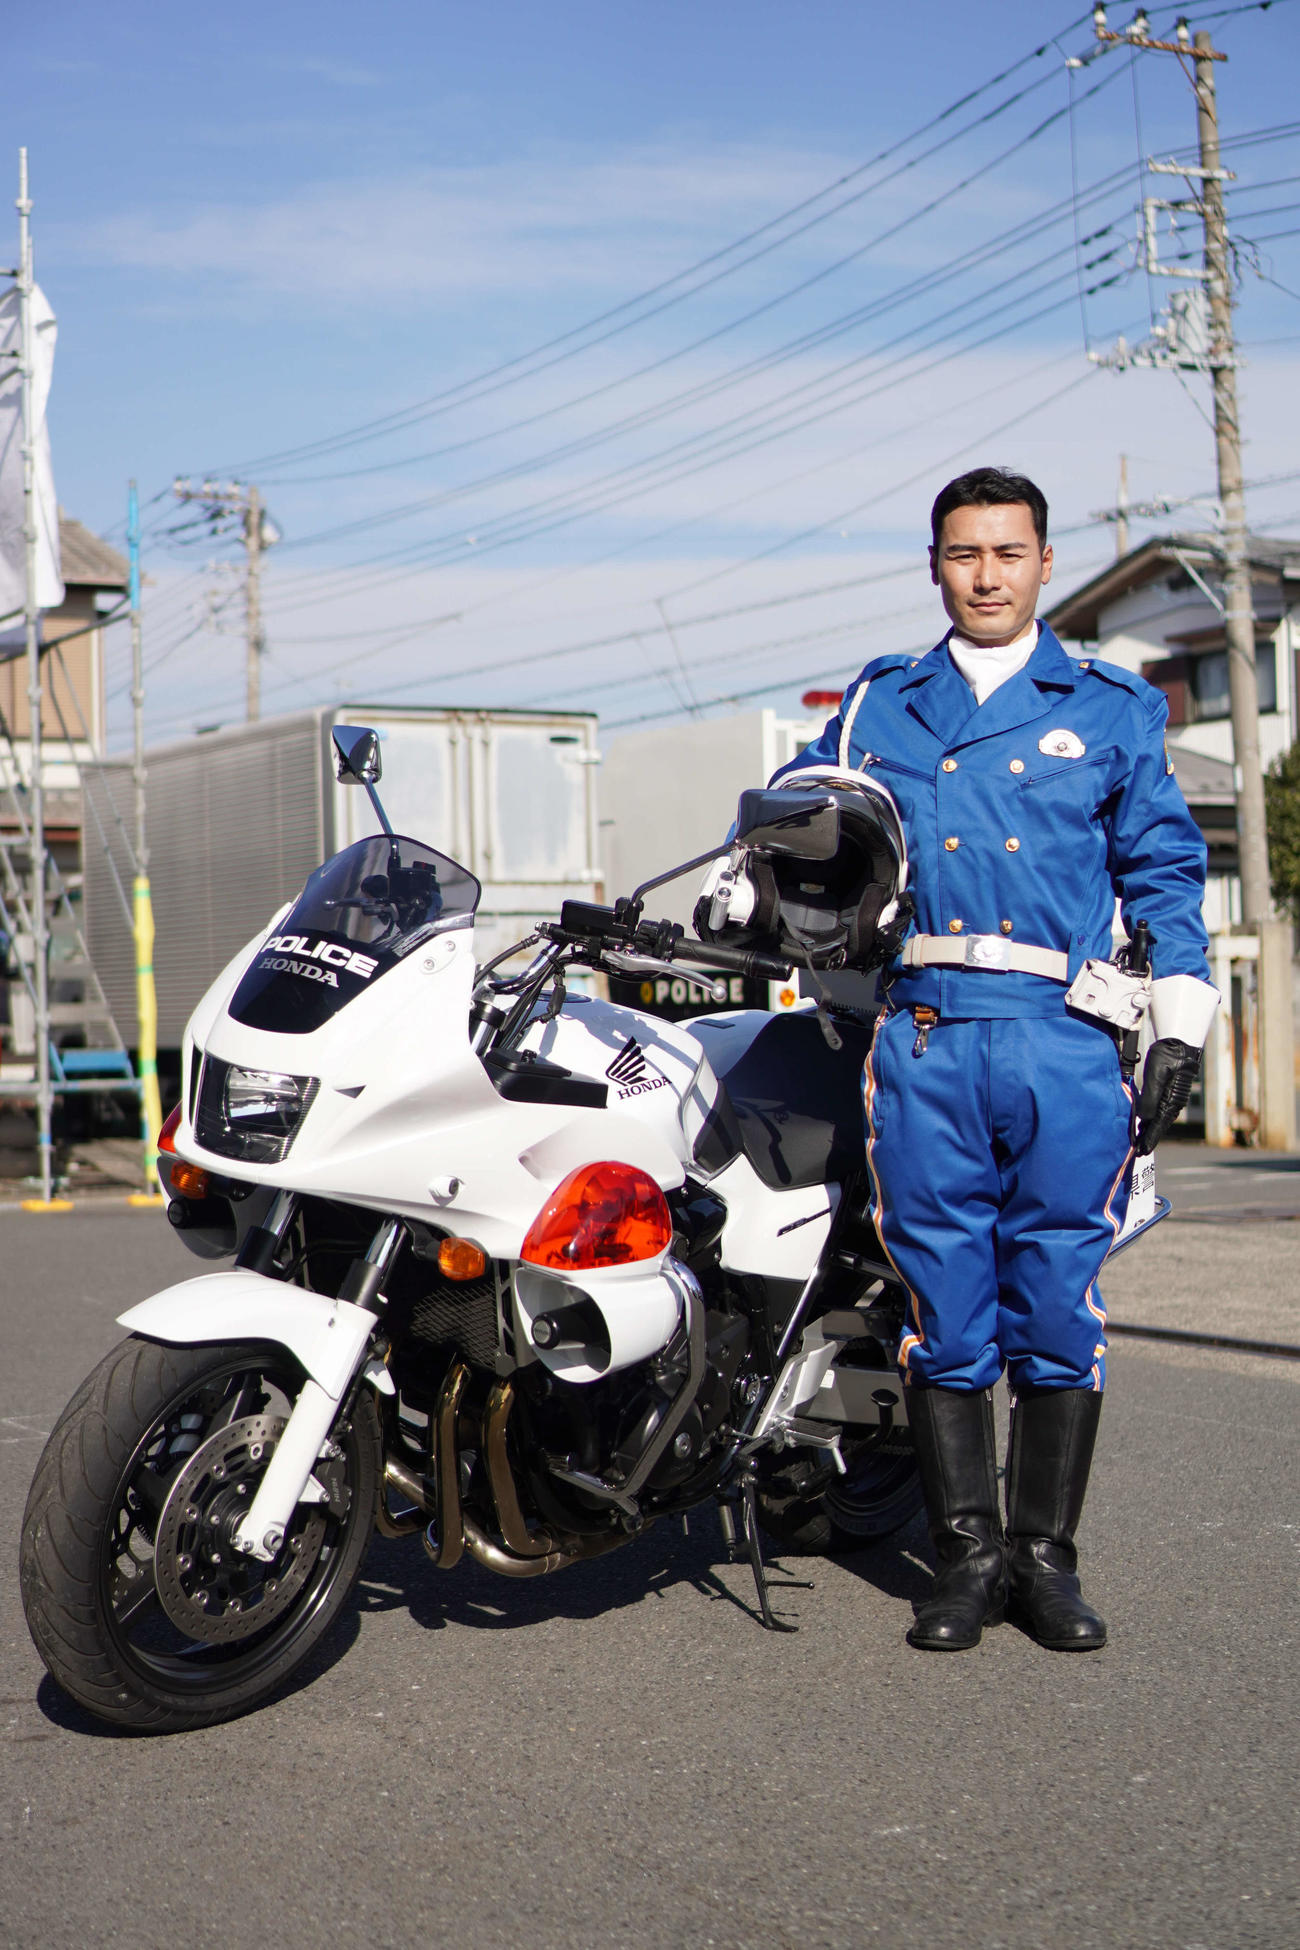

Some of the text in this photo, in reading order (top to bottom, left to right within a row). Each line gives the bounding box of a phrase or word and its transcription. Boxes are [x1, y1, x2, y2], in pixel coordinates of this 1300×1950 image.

[258, 957, 340, 988] HONDA
[261, 935, 379, 979] POLICE
[617, 1076, 673, 1100] HONDA
